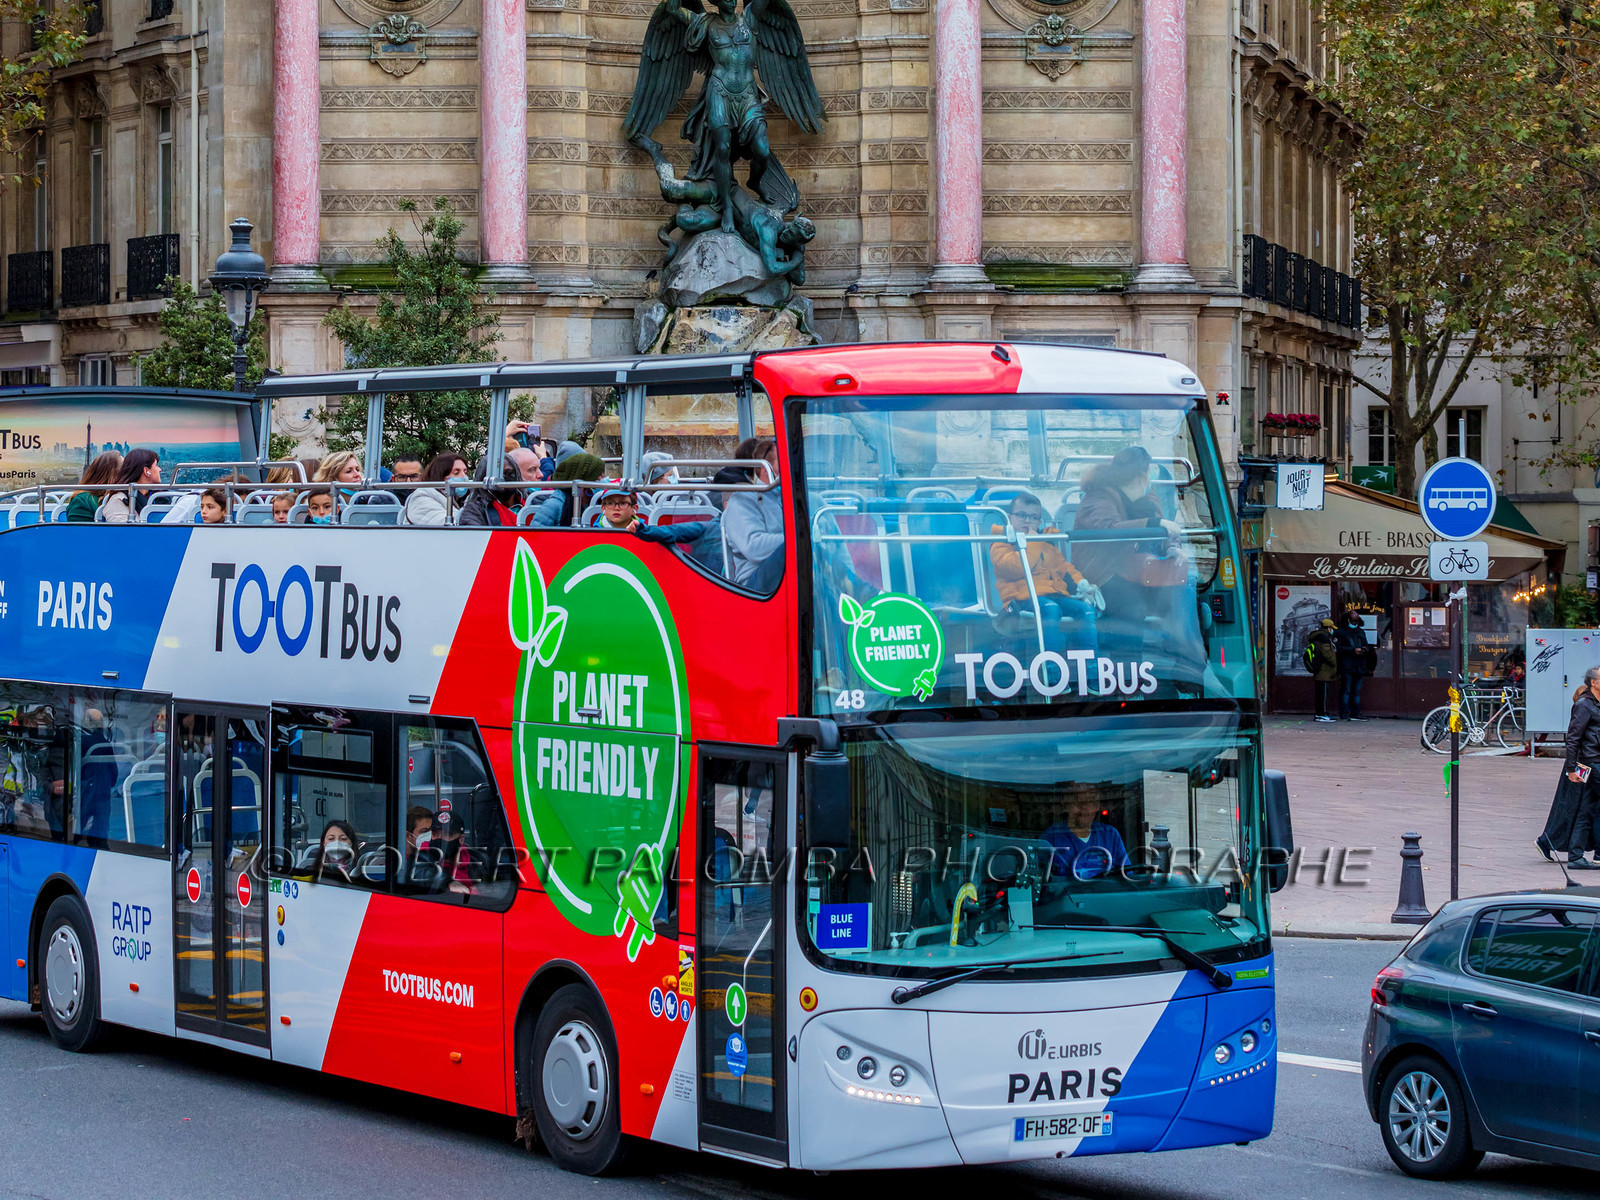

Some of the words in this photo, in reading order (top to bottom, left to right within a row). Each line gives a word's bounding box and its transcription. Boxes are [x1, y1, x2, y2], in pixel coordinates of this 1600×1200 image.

[1286, 469, 1306, 486] JOUR
[1292, 477, 1311, 494] NUIT
[1339, 531, 1372, 547] CAFE
[1308, 557, 1331, 579] La
[1334, 556, 1404, 576] Fontaine
[37, 580, 114, 631] PARIS
[871, 624, 922, 642] PLANET
[865, 643, 931, 662] FRIENDLY
[552, 670, 649, 728] PLANET
[835, 689, 866, 710] 48
[536, 736, 660, 801] FRIENDLY
[112, 901, 152, 935] RATP
[830, 913, 854, 925] BLUE
[831, 927, 852, 939] LINE
[112, 935, 152, 963] GROUP
[382, 968, 475, 1009] TOOTBUS.COM
[1007, 1067, 1122, 1104] PARIS
